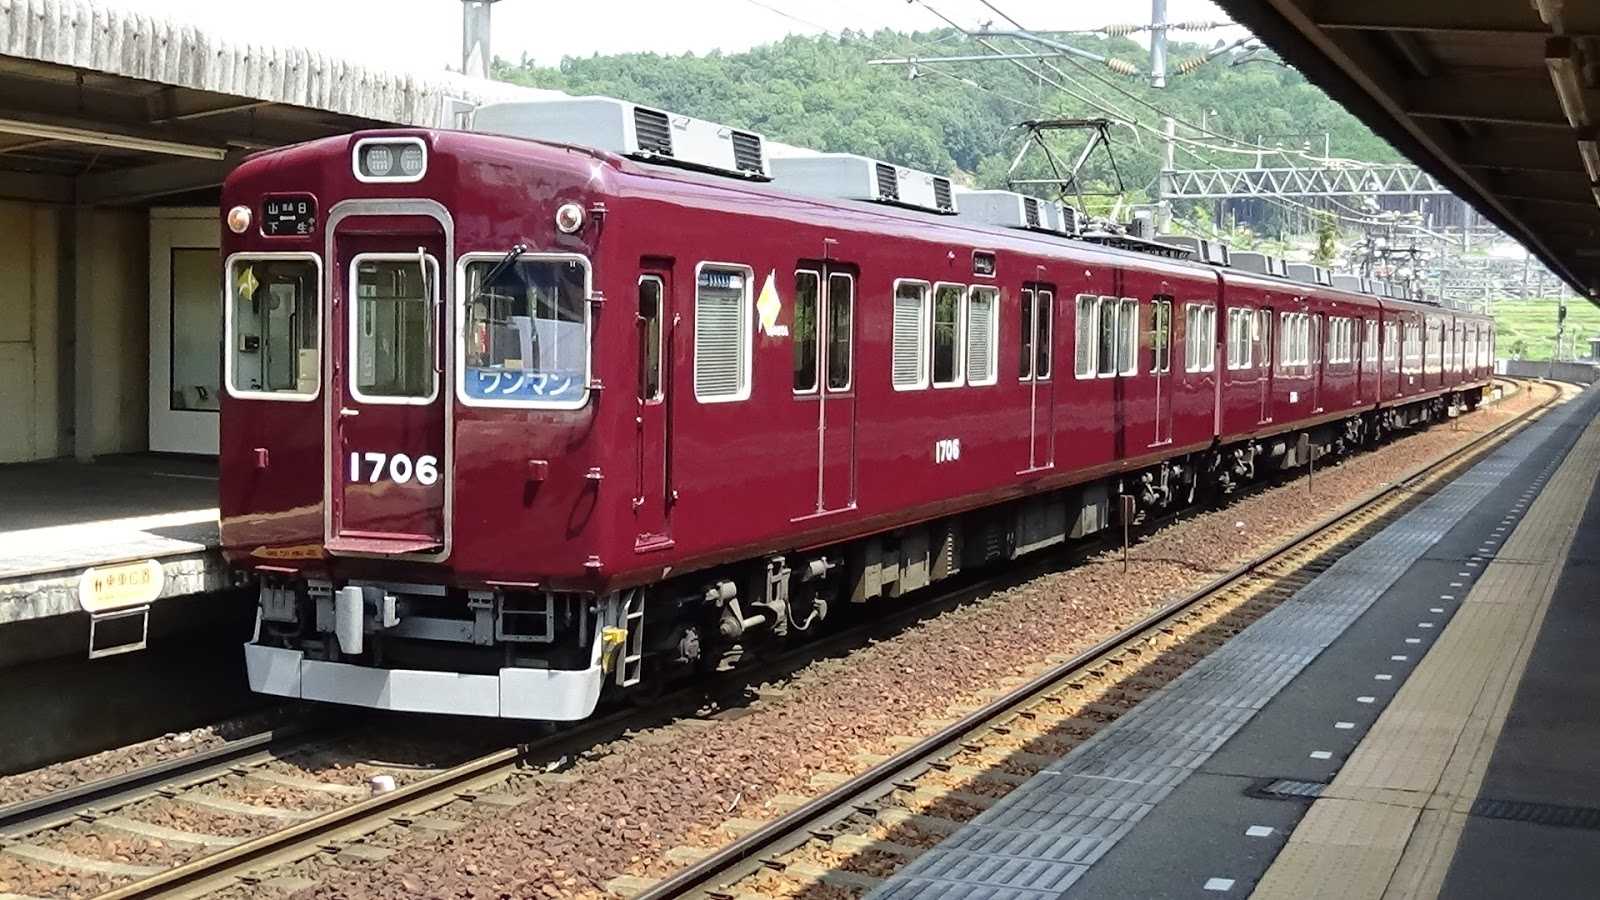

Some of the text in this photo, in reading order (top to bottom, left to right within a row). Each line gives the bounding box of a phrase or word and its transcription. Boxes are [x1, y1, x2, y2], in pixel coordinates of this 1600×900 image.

[479, 372, 571, 395] ワンマン
[936, 438, 960, 464] 1706
[350, 451, 438, 485] 1706
